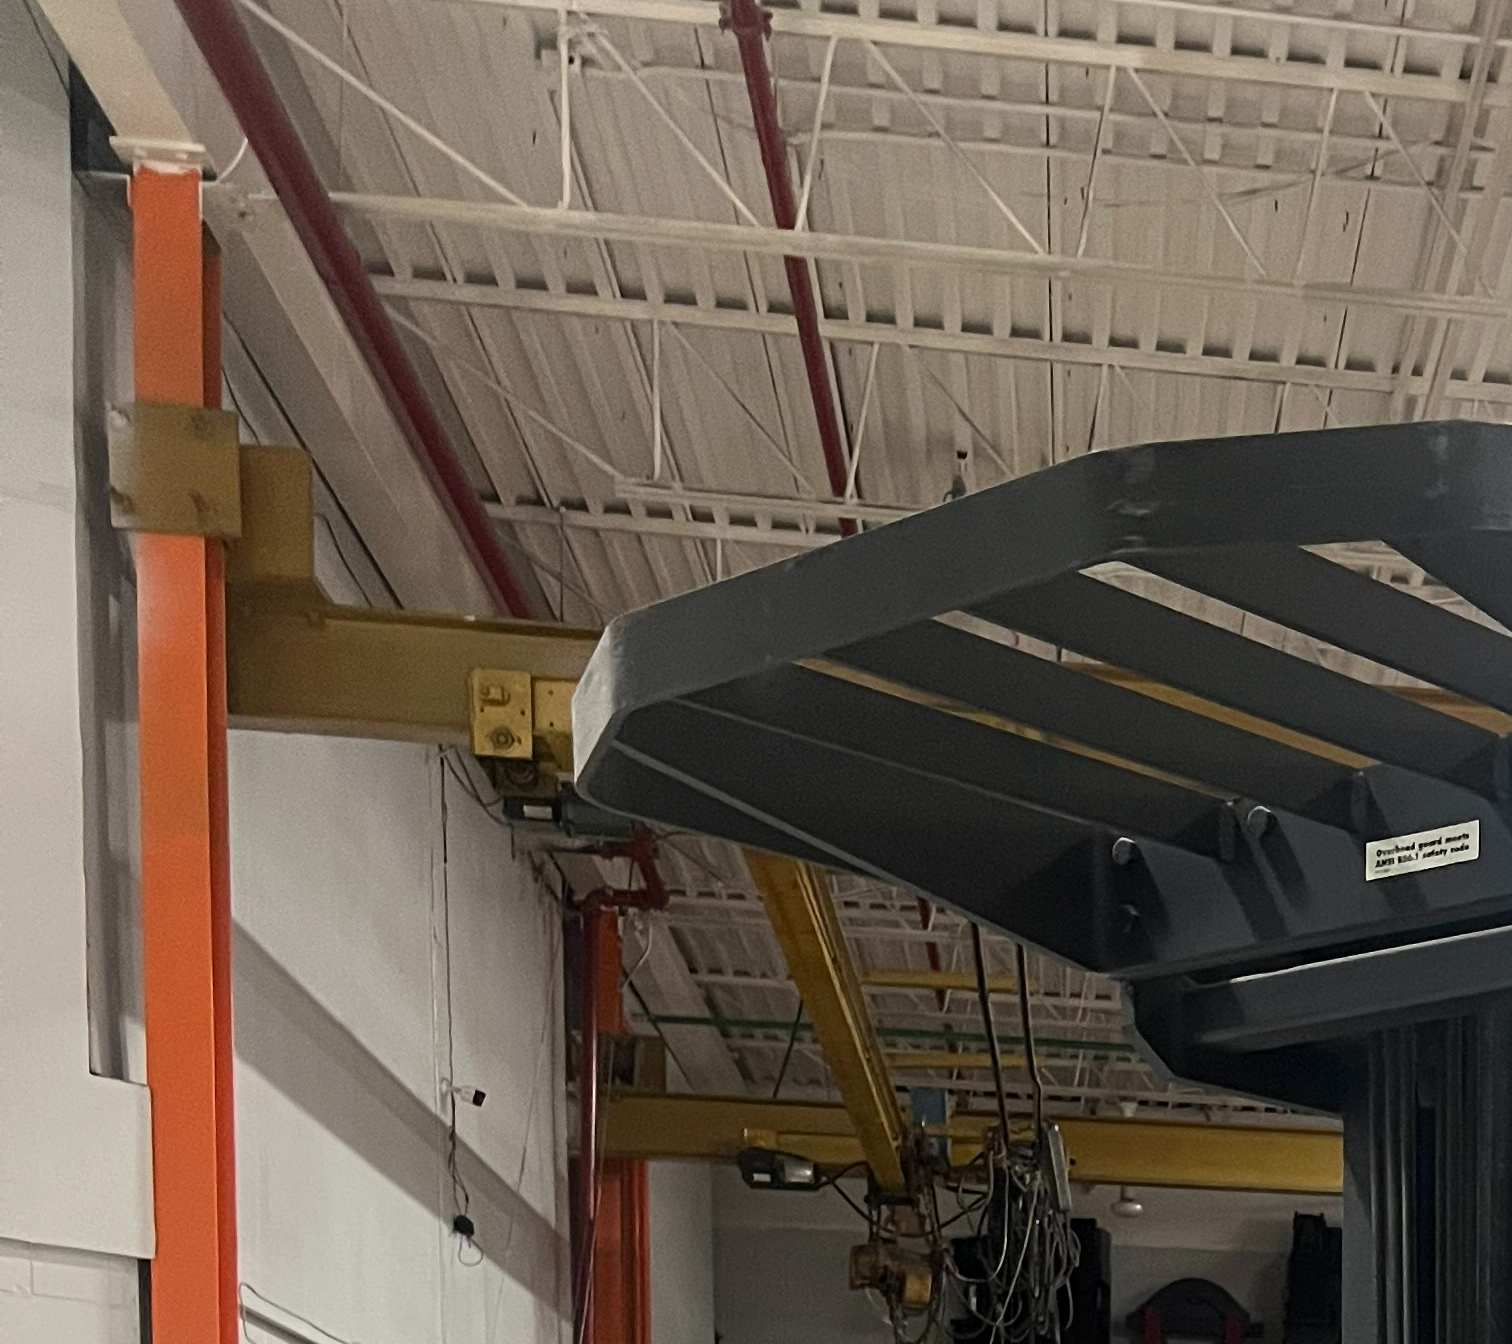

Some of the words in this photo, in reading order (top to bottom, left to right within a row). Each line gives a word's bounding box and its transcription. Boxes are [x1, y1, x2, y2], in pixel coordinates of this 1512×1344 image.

[1375, 857, 1395, 868] ANSI
[1422, 849, 1447, 860] safety
[1450, 843, 1470, 853] code
[1376, 842, 1416, 857] Overhead
[1418, 837, 1442, 851] guard
[1445, 833, 1470, 843] meets
